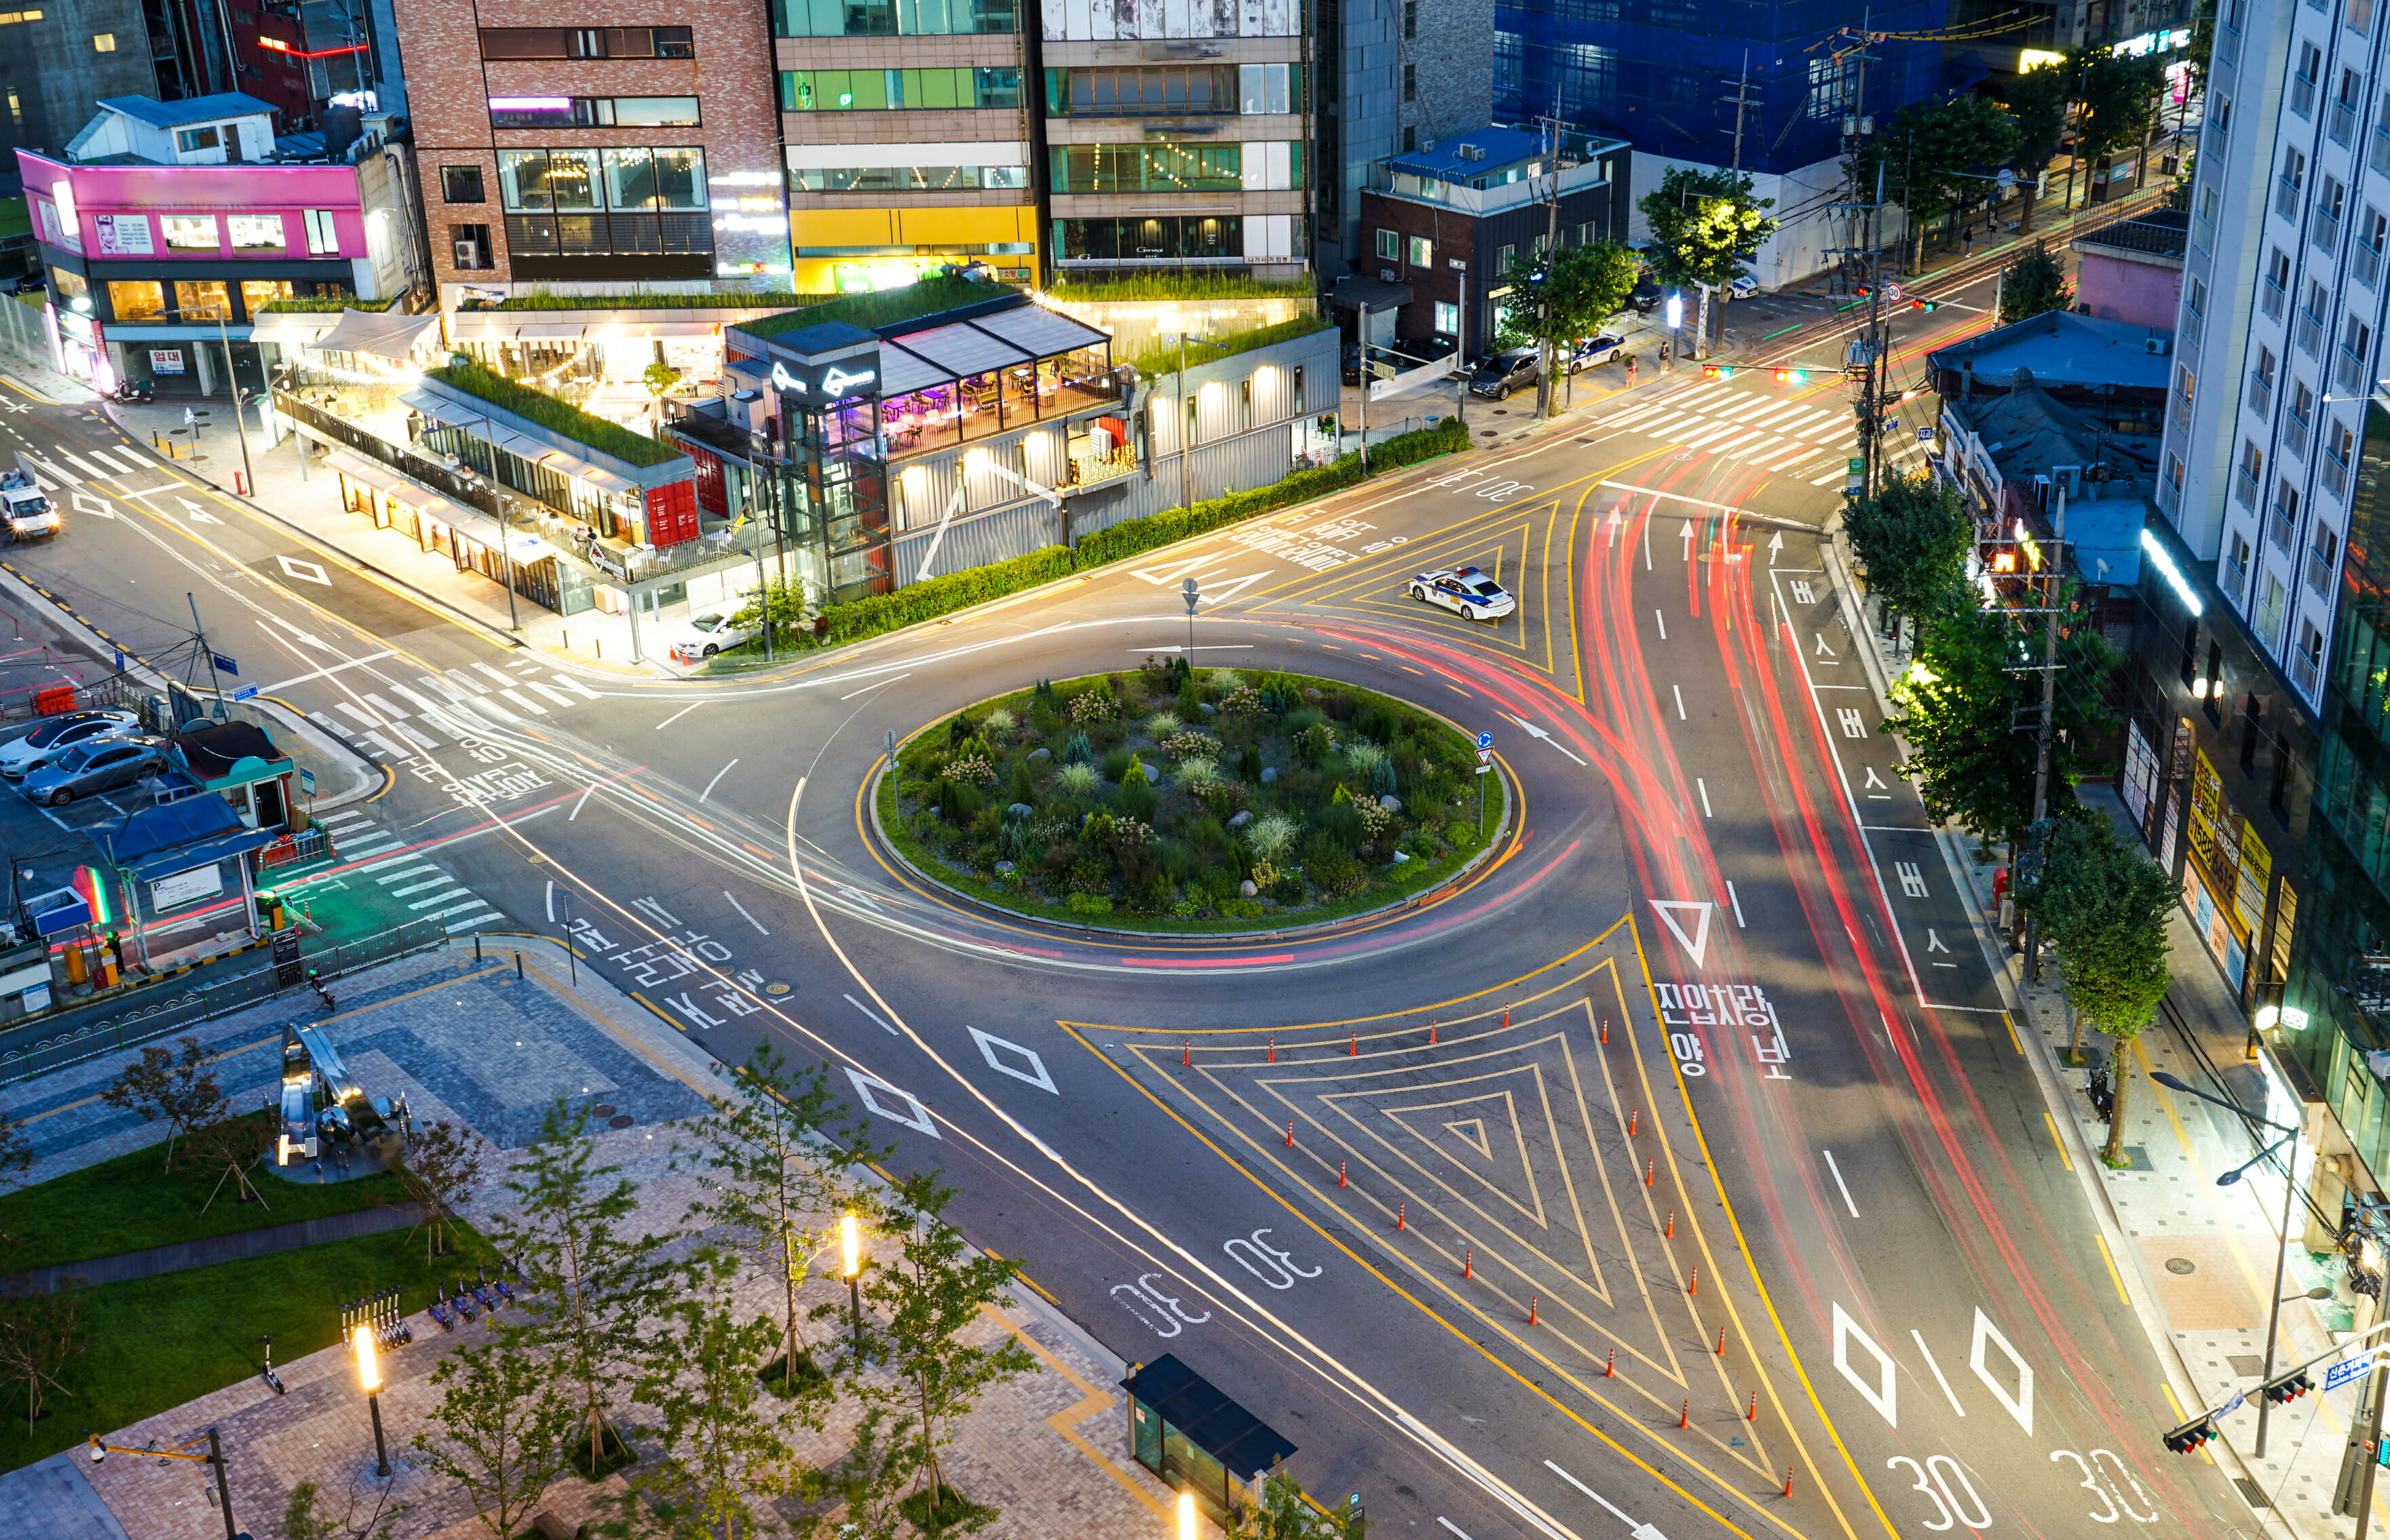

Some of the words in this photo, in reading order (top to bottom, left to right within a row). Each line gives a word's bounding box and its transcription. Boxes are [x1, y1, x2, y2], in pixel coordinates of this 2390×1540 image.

[1889, 288, 1899, 297] 30
[153, 351, 180, 362] 임대
[1920, 428, 1931, 439] 치과
[1475, 480, 1535, 502] 30
[1654, 983, 1770, 1026] 진입차량
[1222, 1228, 1323, 1290] 30
[1109, 1273, 1211, 1339] 30
[2328, 1372, 2349, 1389] Sinchon
[1886, 1454, 1993, 1532] 30
[2049, 1448, 2160, 1524] 30
